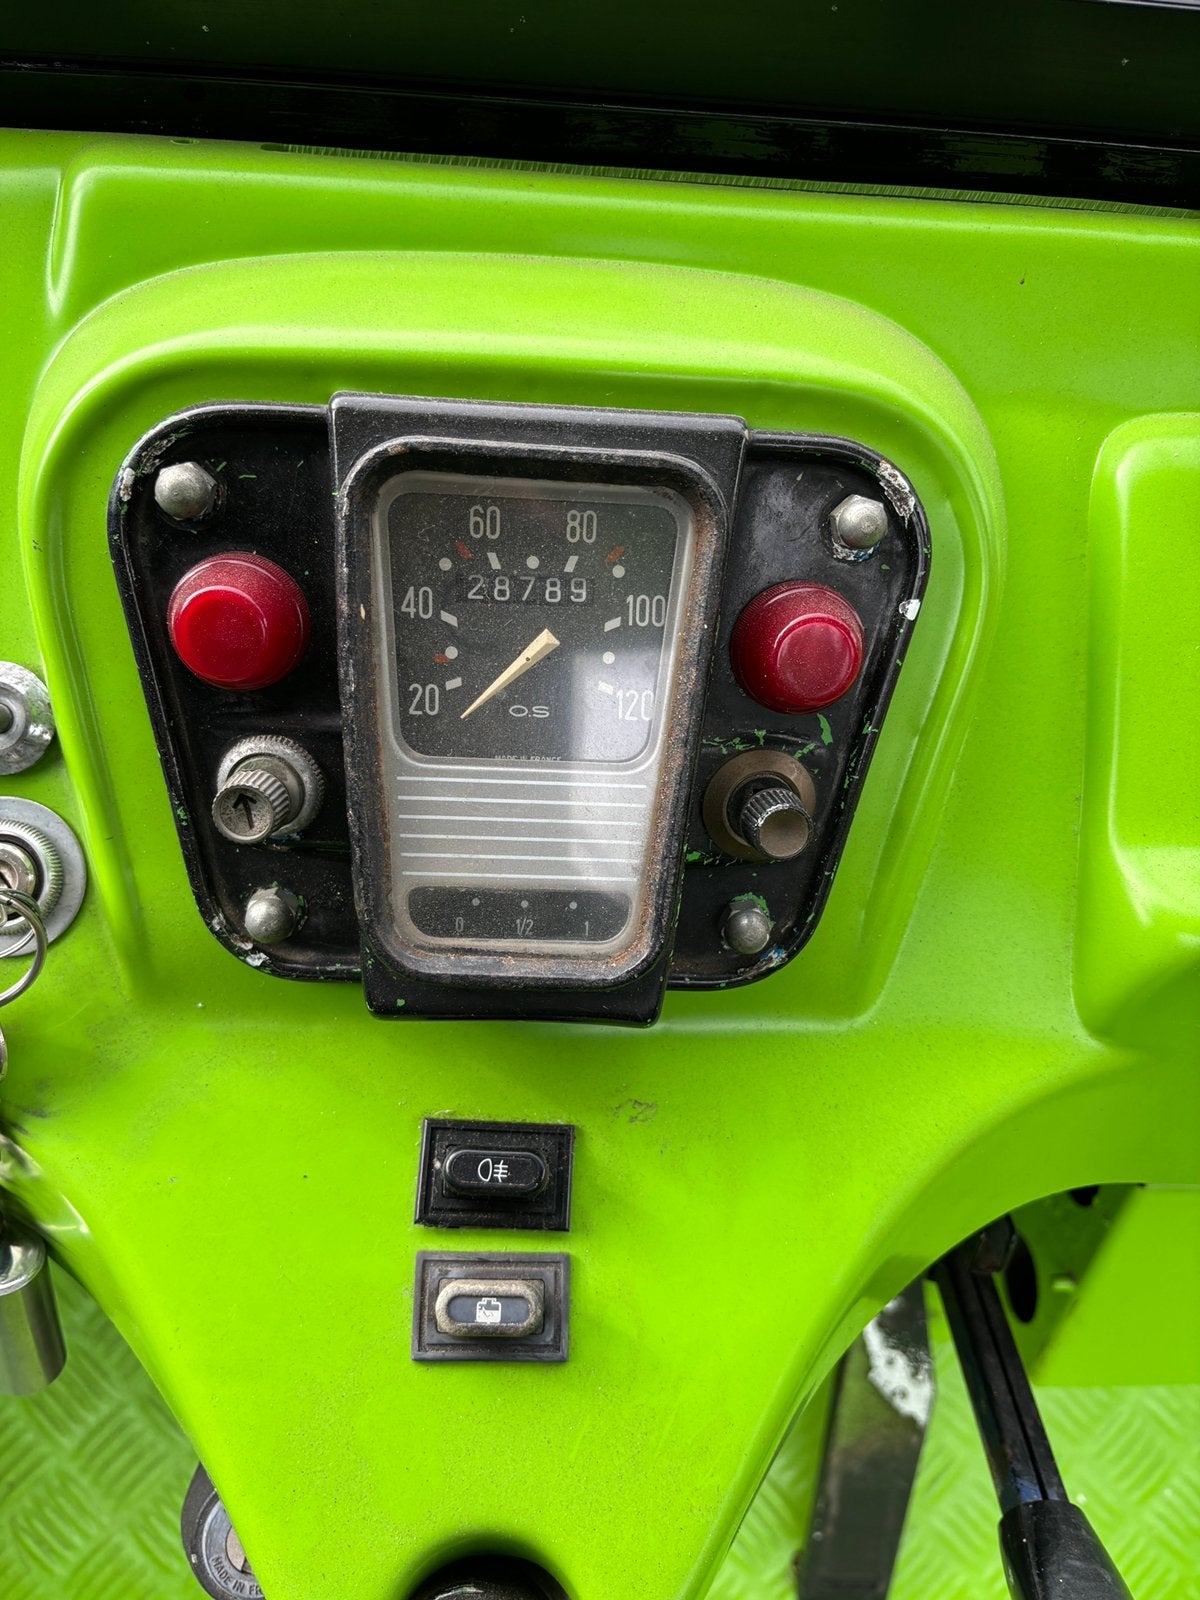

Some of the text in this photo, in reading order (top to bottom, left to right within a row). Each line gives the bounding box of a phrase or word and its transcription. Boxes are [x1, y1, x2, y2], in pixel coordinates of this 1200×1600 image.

[469, 505, 501, 540] 60
[566, 510, 597, 544] 80
[401, 586, 433, 619] 40
[467, 574, 588, 603] 28789
[626, 594, 666, 628] 100
[408, 683, 440, 716] 20
[616, 689, 655, 721] 120
[455, 916, 465, 932] 0
[516, 919, 534, 936] 1/2
[583, 920, 590, 937] 1
[211, 1555, 233, 1586] MADE
[231, 1579, 246, 1593] IN
